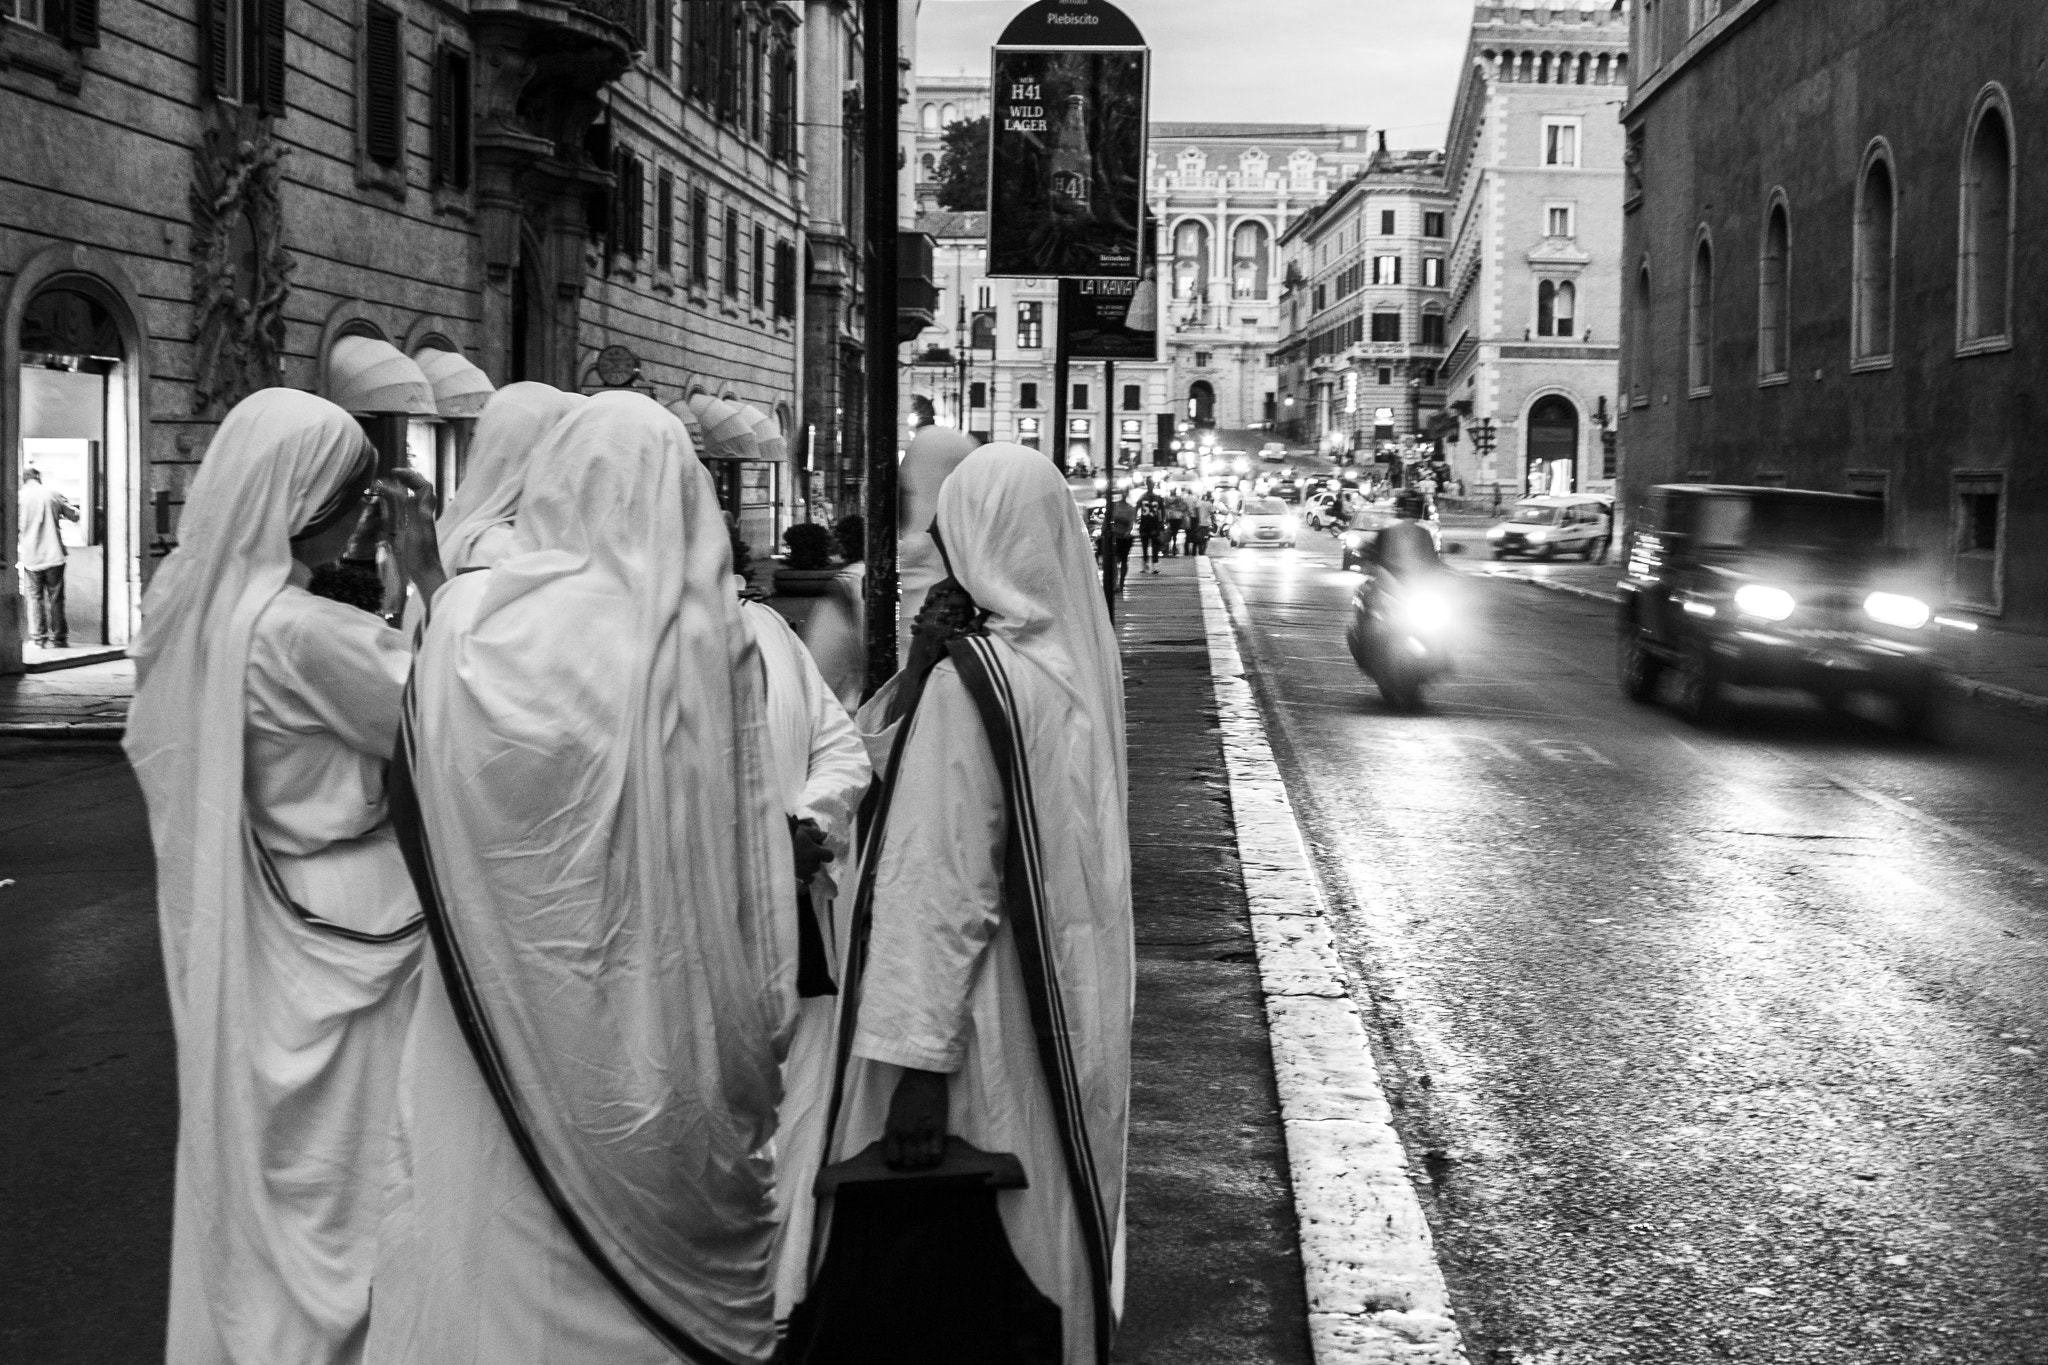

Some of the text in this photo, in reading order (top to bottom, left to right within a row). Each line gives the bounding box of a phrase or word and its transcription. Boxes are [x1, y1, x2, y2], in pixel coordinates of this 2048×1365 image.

[1047, 12, 1099, 25] Plebiscito
[1011, 84, 1042, 100] H41
[1009, 105, 1044, 118] WILD
[1004, 119, 1048, 131] LAGER
[1080, 279, 1095, 295] LA
